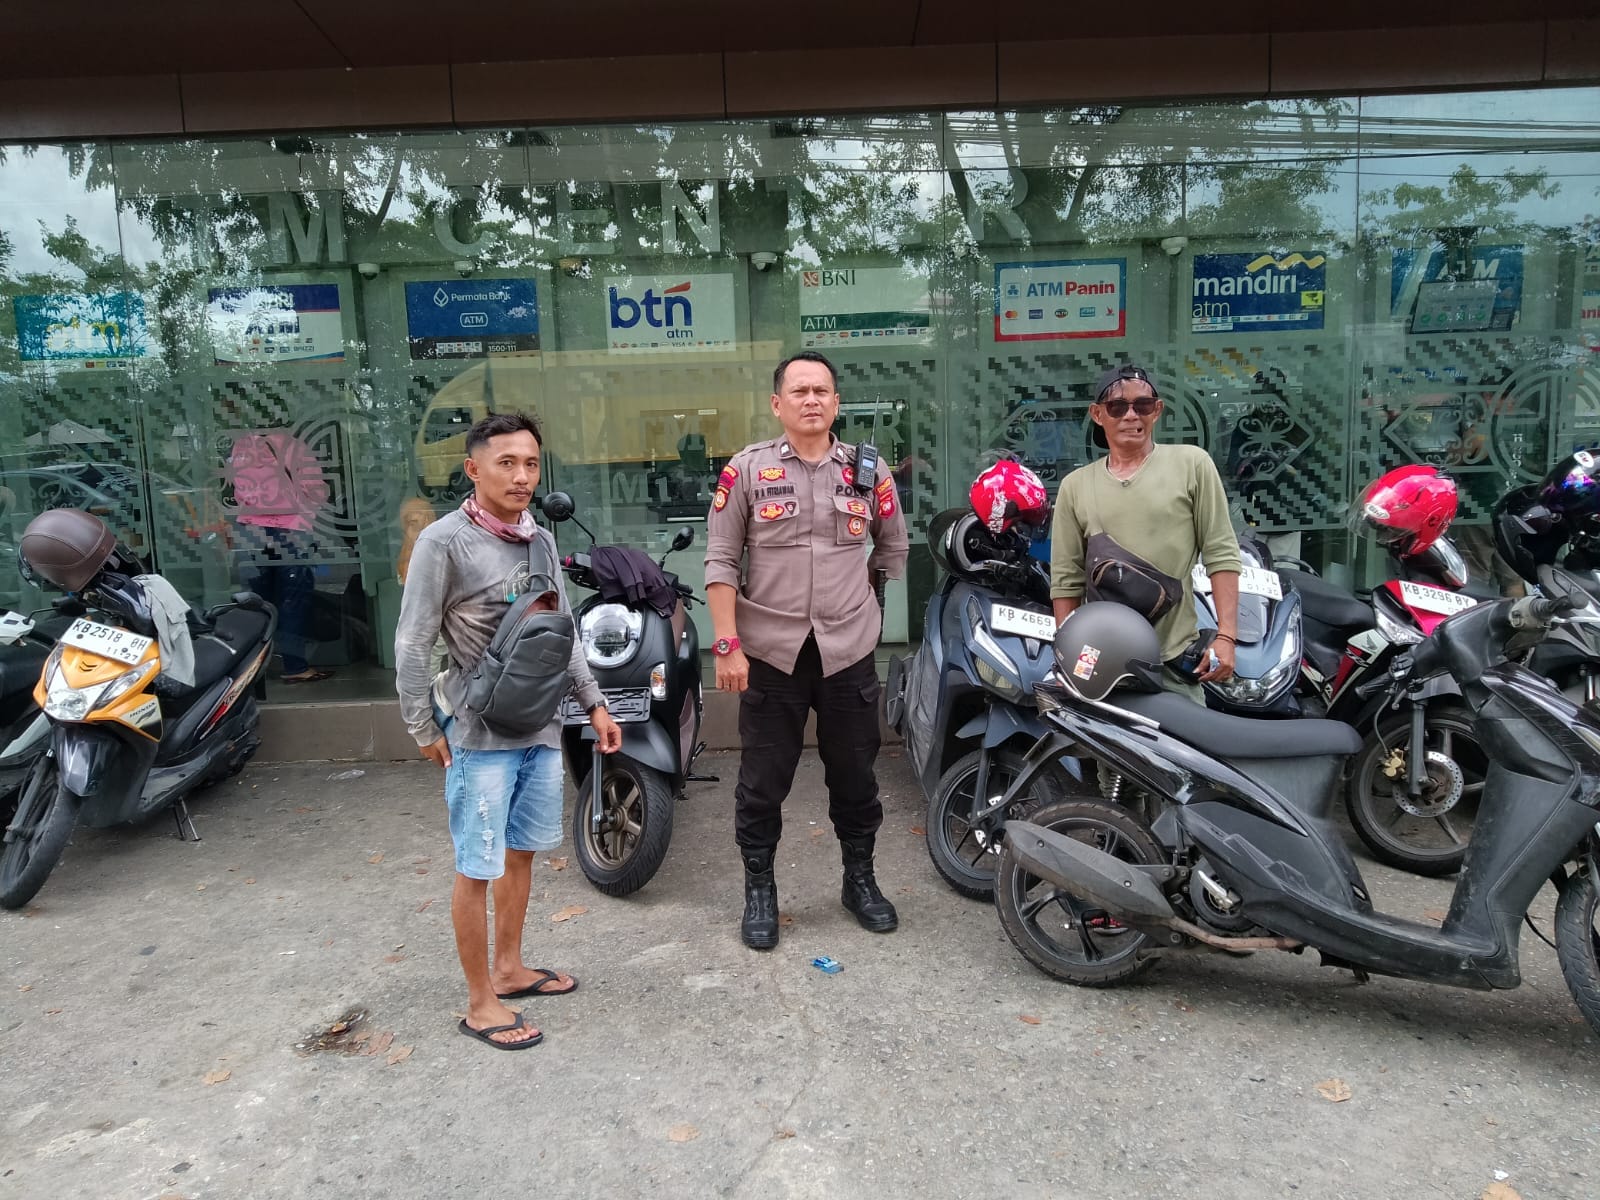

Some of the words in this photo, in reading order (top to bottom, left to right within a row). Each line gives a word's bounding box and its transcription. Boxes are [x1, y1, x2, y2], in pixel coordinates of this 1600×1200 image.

[822, 269, 856, 286] BNI
[1193, 268, 1297, 297] mandiri
[1027, 281, 1063, 297] ATM
[1065, 280, 1115, 296] Panin
[451, 293, 488, 302] Permata
[489, 291, 511, 301] Bank
[609, 285, 693, 328] btn
[1192, 301, 1230, 318] atm
[464, 315, 484, 324] ATM
[804, 316, 836, 330] ATM
[666, 328, 693, 338] atm
[1403, 583, 1420, 595] KB
[998, 606, 1015, 619] KB
[72, 620, 92, 634] KB
[89, 626, 123, 643] 2518
